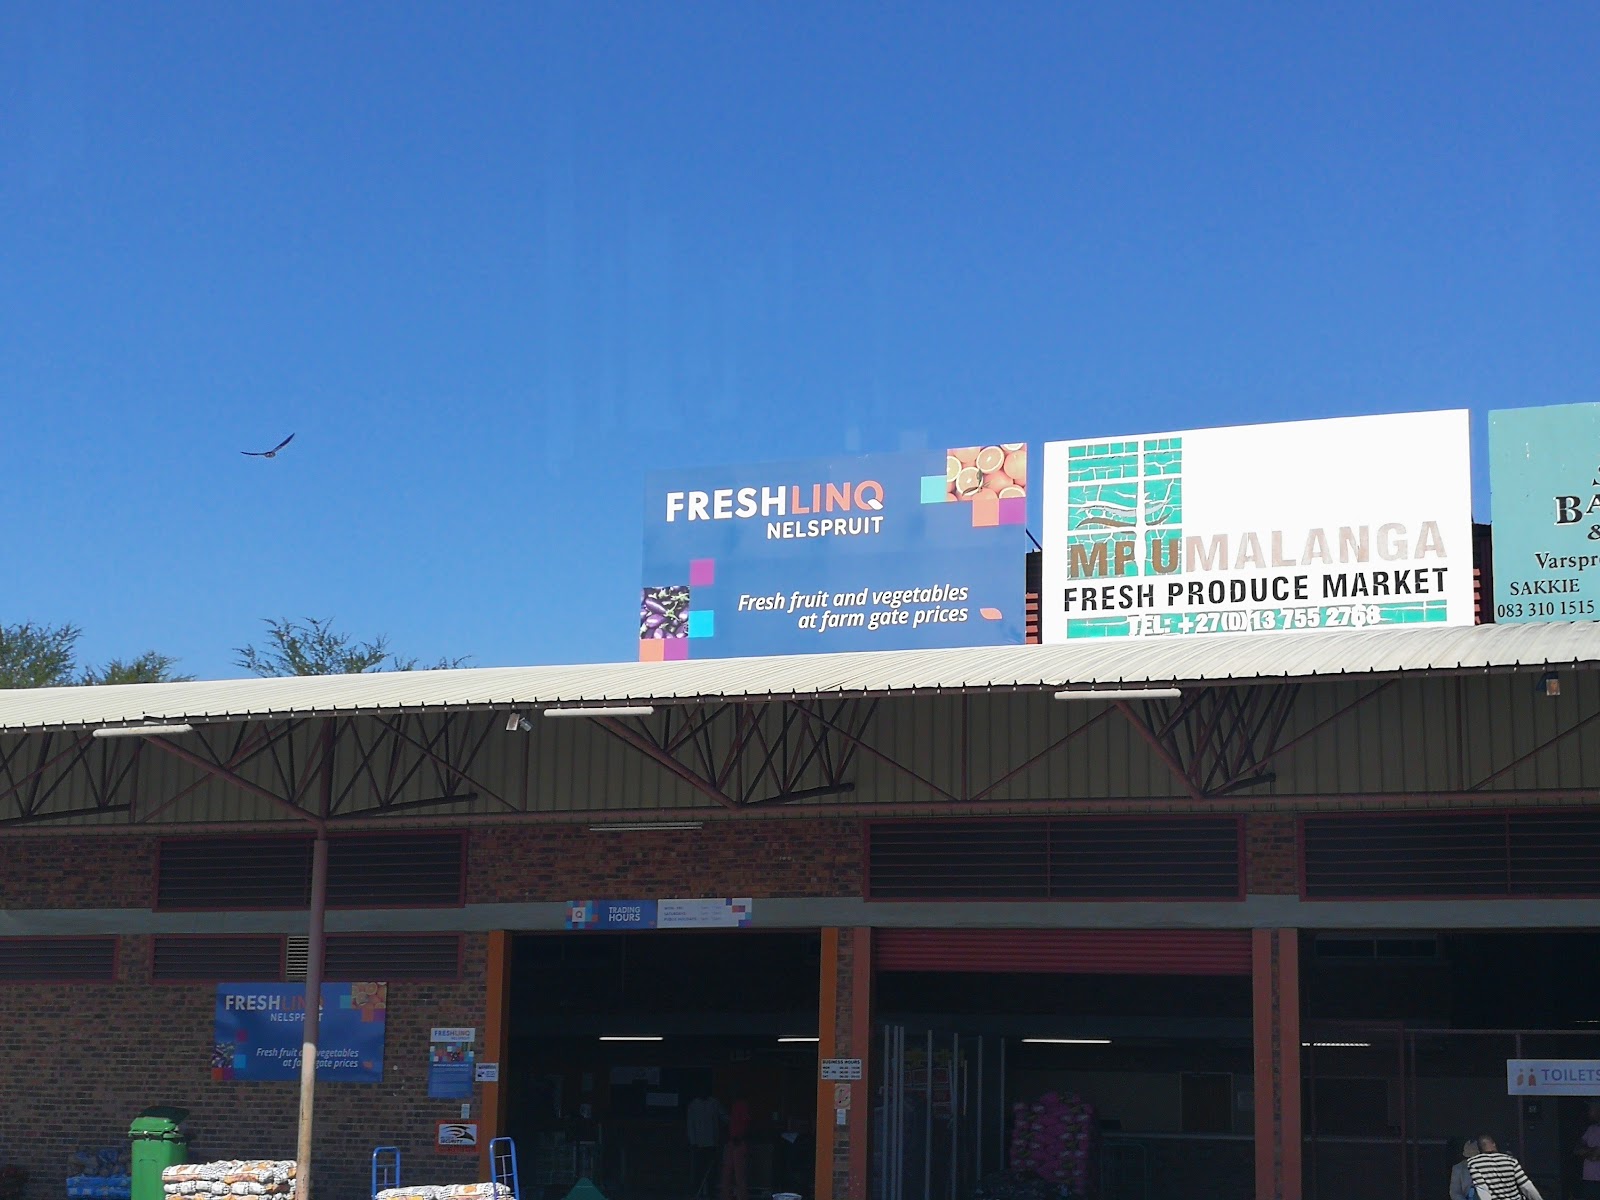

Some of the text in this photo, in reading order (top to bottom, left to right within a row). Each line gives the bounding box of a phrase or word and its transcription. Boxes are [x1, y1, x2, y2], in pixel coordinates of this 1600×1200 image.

[666, 480, 885, 522] FRESHLINQ
[767, 516, 884, 540] NELSPRUIT
[1535, 552, 1600, 572] Varspr
[1064, 568, 1448, 612] FRESH PRODUCE MARKET
[1510, 578, 1580, 595] SAKKIE
[738, 584, 968, 613] Fresh fruit and vegetables
[1497, 600, 1594, 618] 083 310 1515
[798, 606, 968, 633] at farm gate prices
[1280, 607, 1320, 630] 755
[609, 906, 641, 914] TRADING
[609, 913, 641, 922] HOURS
[225, 995, 323, 1010] FRESHLIN
[270, 1012, 323, 1022] NELSPRT
[256, 1048, 278, 1057] Fresh
[279, 1048, 298, 1059] fruit
[283, 1060, 292, 1068] at
[333, 1058, 359, 1069] prices
[1541, 1069, 1600, 1081] TOILETS
